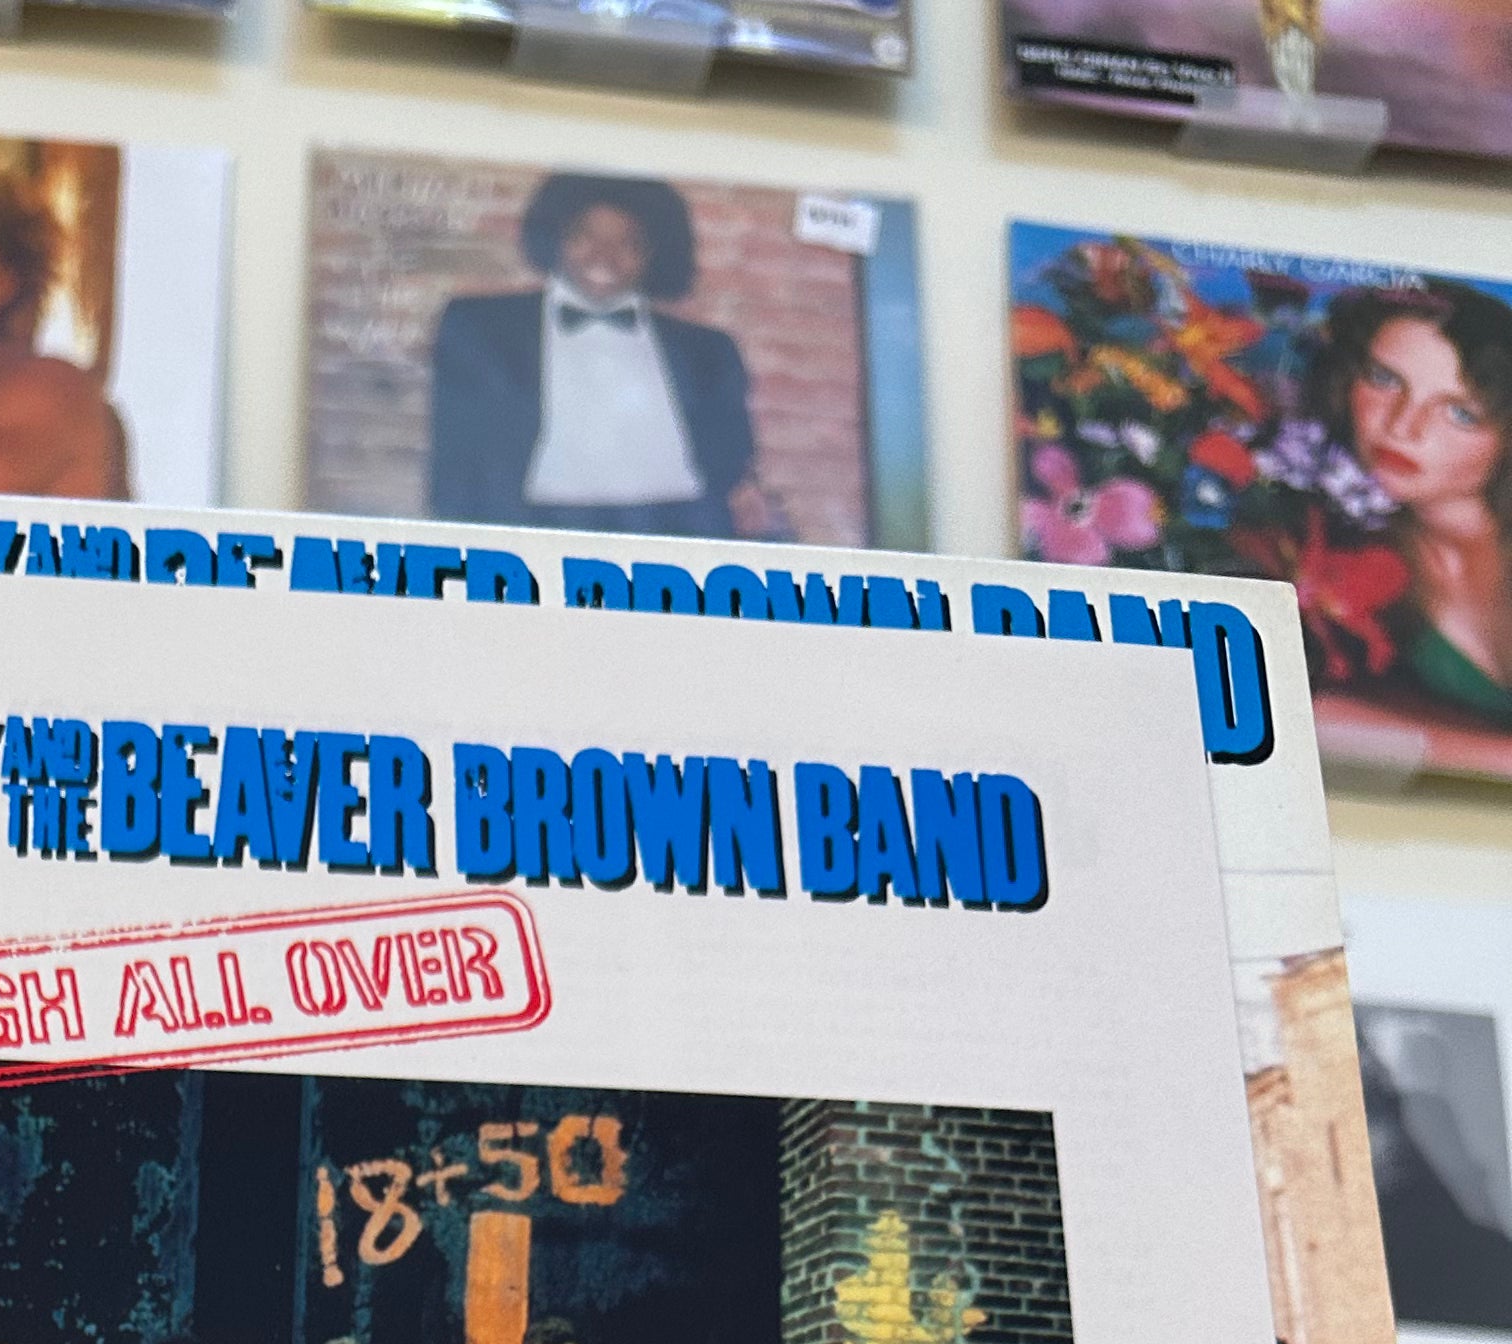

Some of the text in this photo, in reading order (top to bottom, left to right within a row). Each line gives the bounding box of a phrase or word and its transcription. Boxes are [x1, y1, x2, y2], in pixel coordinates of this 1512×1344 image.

[1, 714, 100, 788] AND
[100, 719, 439, 879] BEAVER
[452, 742, 788, 899] BROWN
[794, 761, 1049, 913] BAND
[1, 783, 99, 861] THE
[114, 951, 273, 1038] ALL
[287, 925, 506, 1017] OVER
